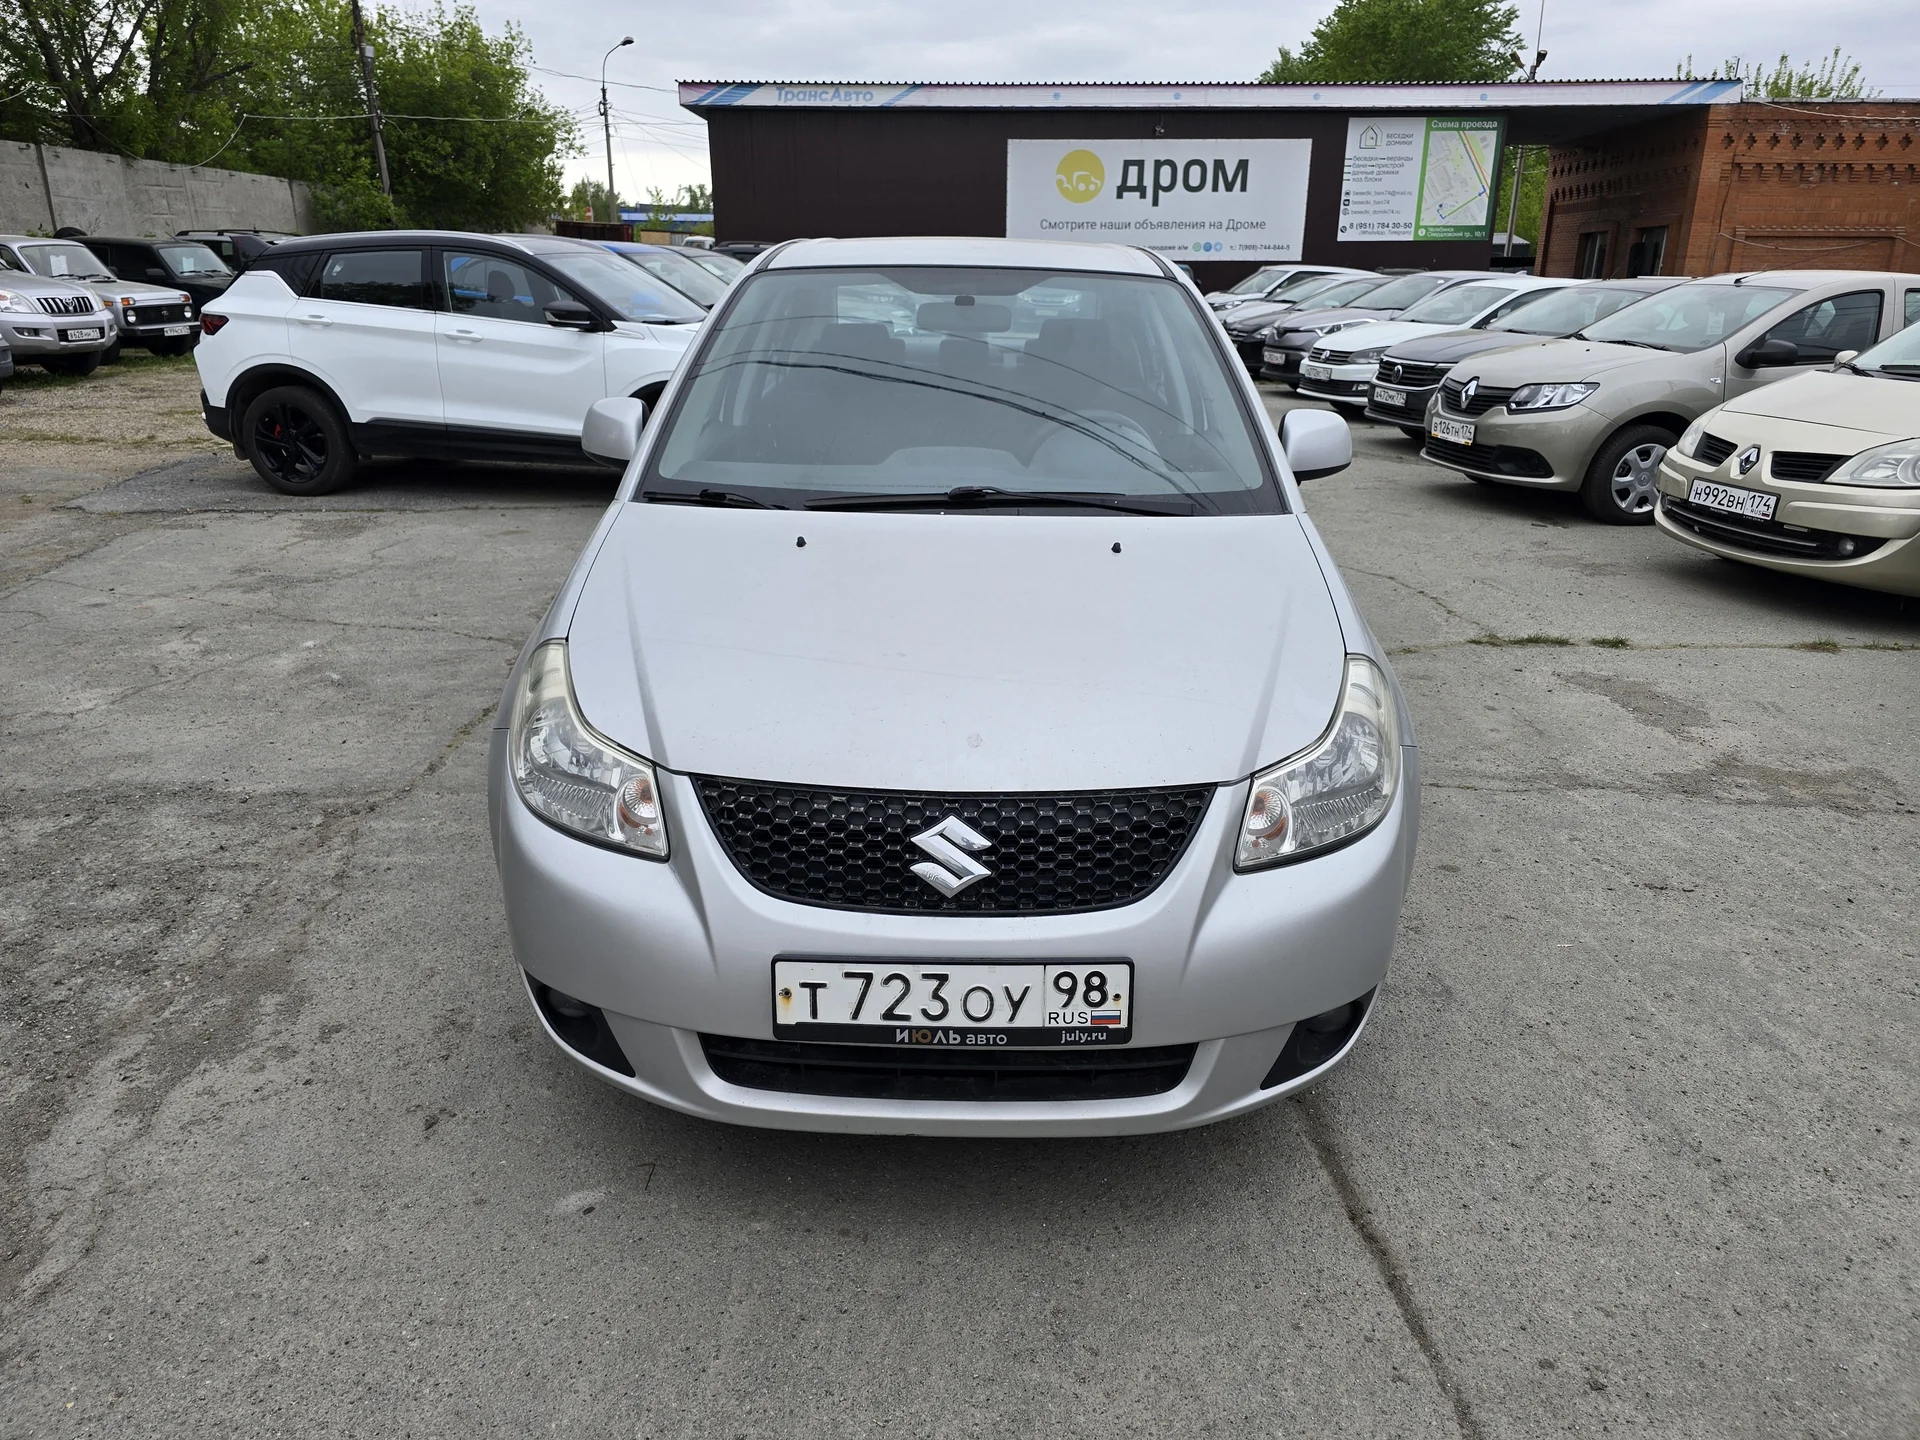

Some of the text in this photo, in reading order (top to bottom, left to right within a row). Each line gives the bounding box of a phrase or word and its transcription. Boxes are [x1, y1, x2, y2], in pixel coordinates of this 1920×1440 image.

[776, 86, 873, 103] ТрансАвто
[1432, 120, 1498, 129] Схема проезда
[1040, 219, 1266, 232] Смотрите наши объявления на Дроме
[1693, 485, 1746, 511] Н992ВН
[1749, 494, 1772, 511] 174
[1750, 508, 1763, 516] RUS
[1052, 970, 1109, 1008] 98
[1048, 1011, 1089, 1025] RUS
[895, 1029, 1008, 1045] ИЮЛЬ авто
[1061, 1030, 1107, 1044] july.ru
